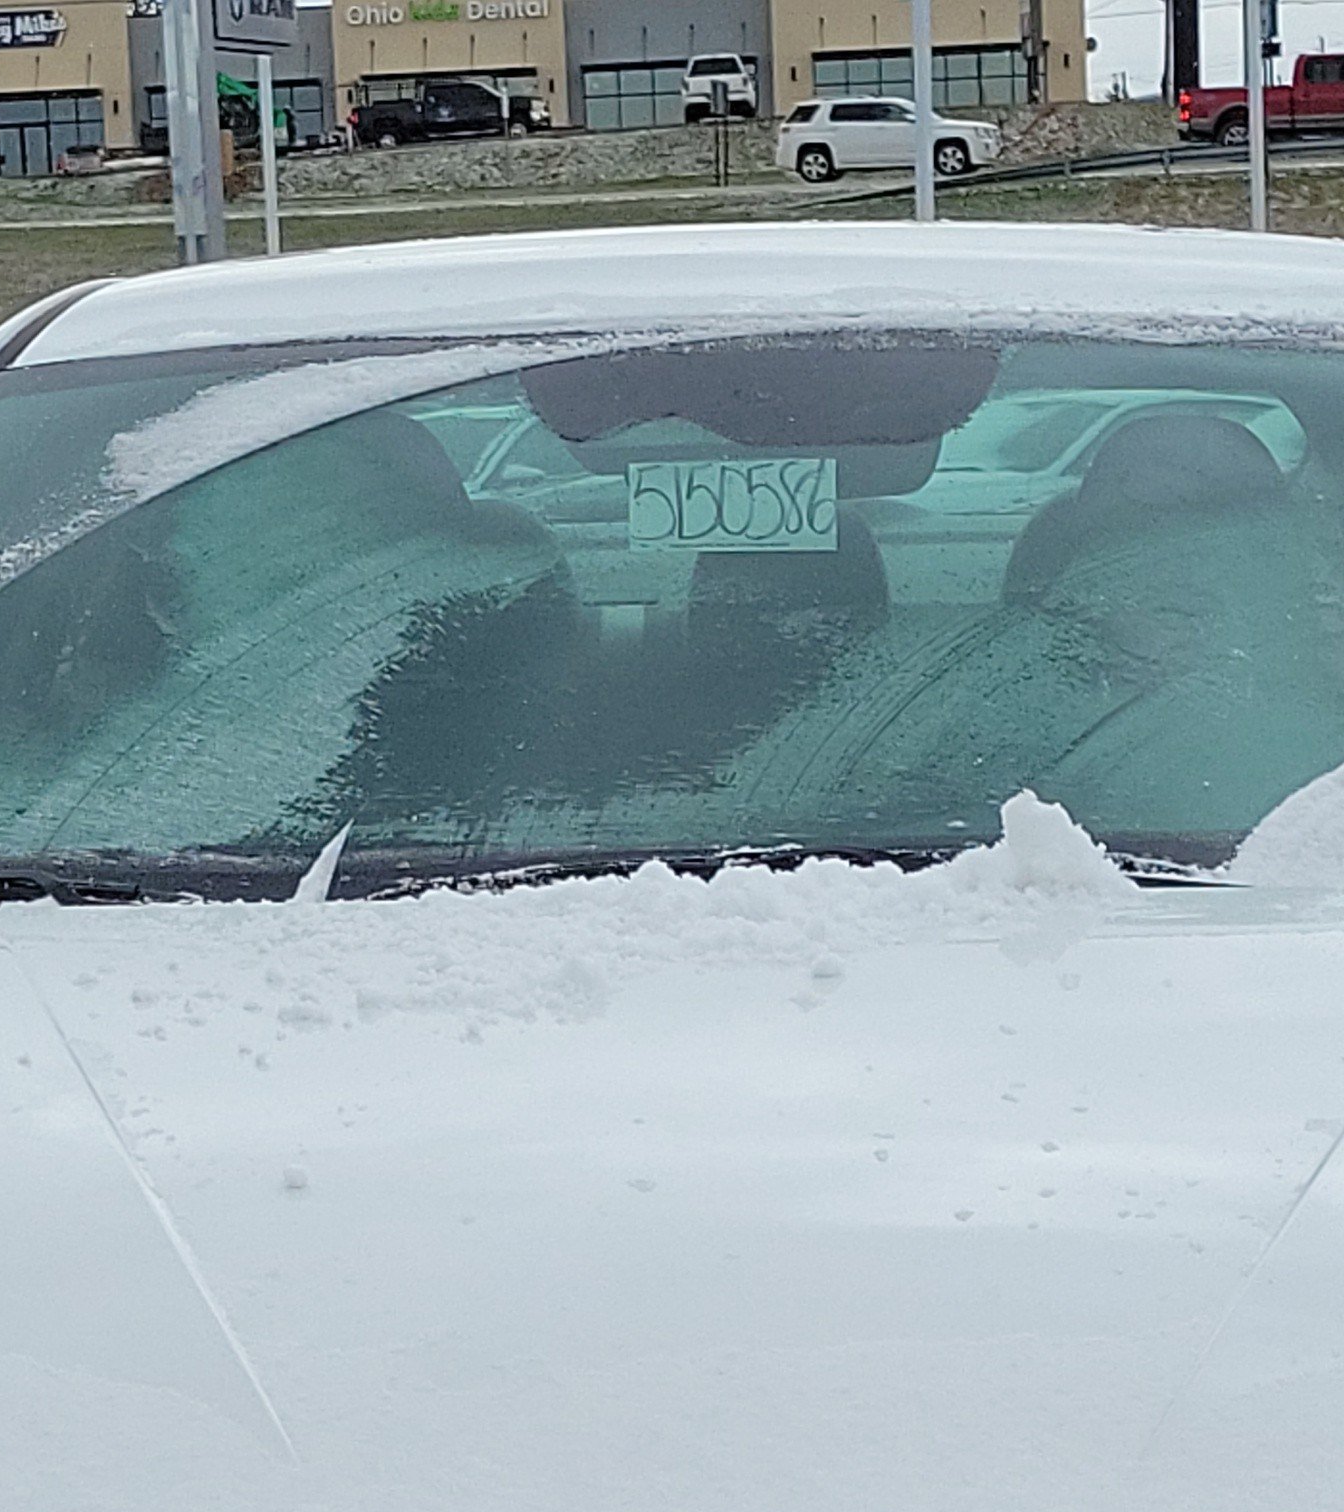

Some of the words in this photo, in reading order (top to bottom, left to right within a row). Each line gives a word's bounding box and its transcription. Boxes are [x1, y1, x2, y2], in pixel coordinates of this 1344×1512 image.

[347, 2, 403, 25] Ohio
[467, 0, 549, 20] Dental
[631, 457, 836, 541] 5150586
